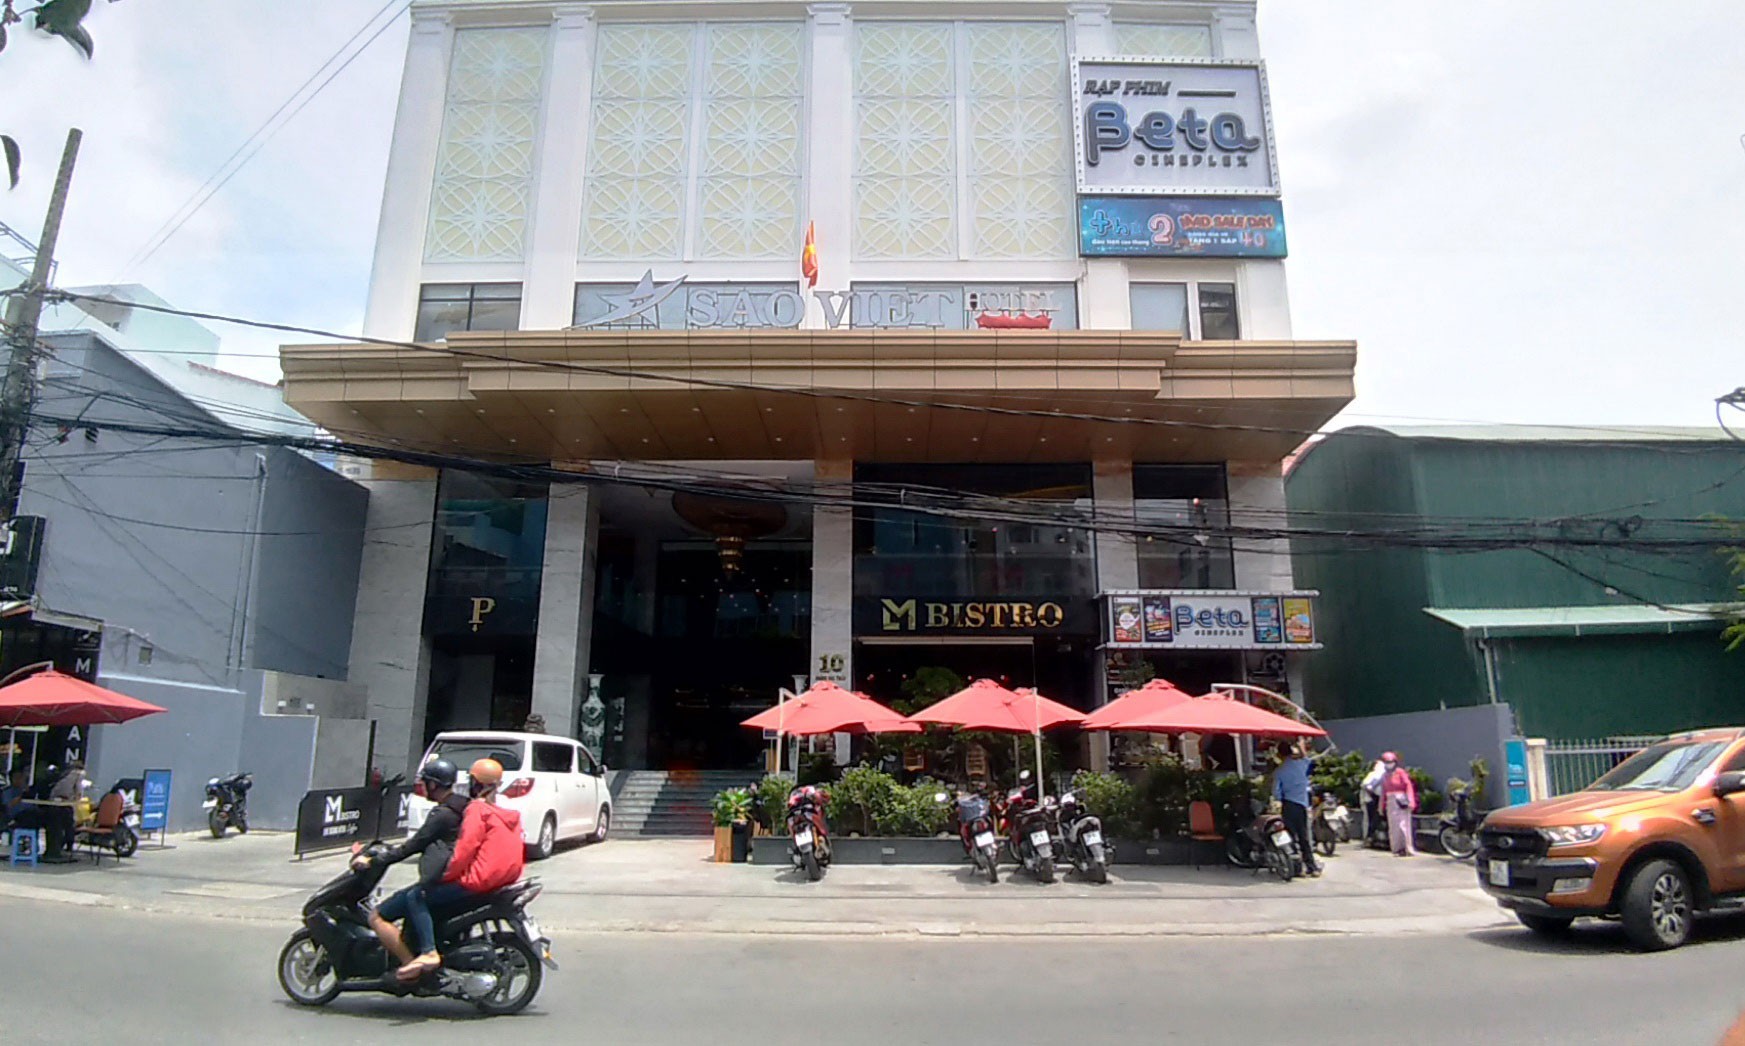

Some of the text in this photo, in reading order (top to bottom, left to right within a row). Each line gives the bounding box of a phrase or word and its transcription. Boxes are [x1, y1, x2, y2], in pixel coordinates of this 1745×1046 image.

[1122, 80, 1171, 97] PHIM
[1084, 101, 1260, 167] Beta
[1133, 154, 1249, 168] CINEPLEX
[687, 288, 806, 328] SAO
[813, 288, 955, 328] VIET
[881, 599, 1064, 631] M BISTRO
[1174, 605, 1250, 636] Beta
[819, 653, 845, 674] 10
